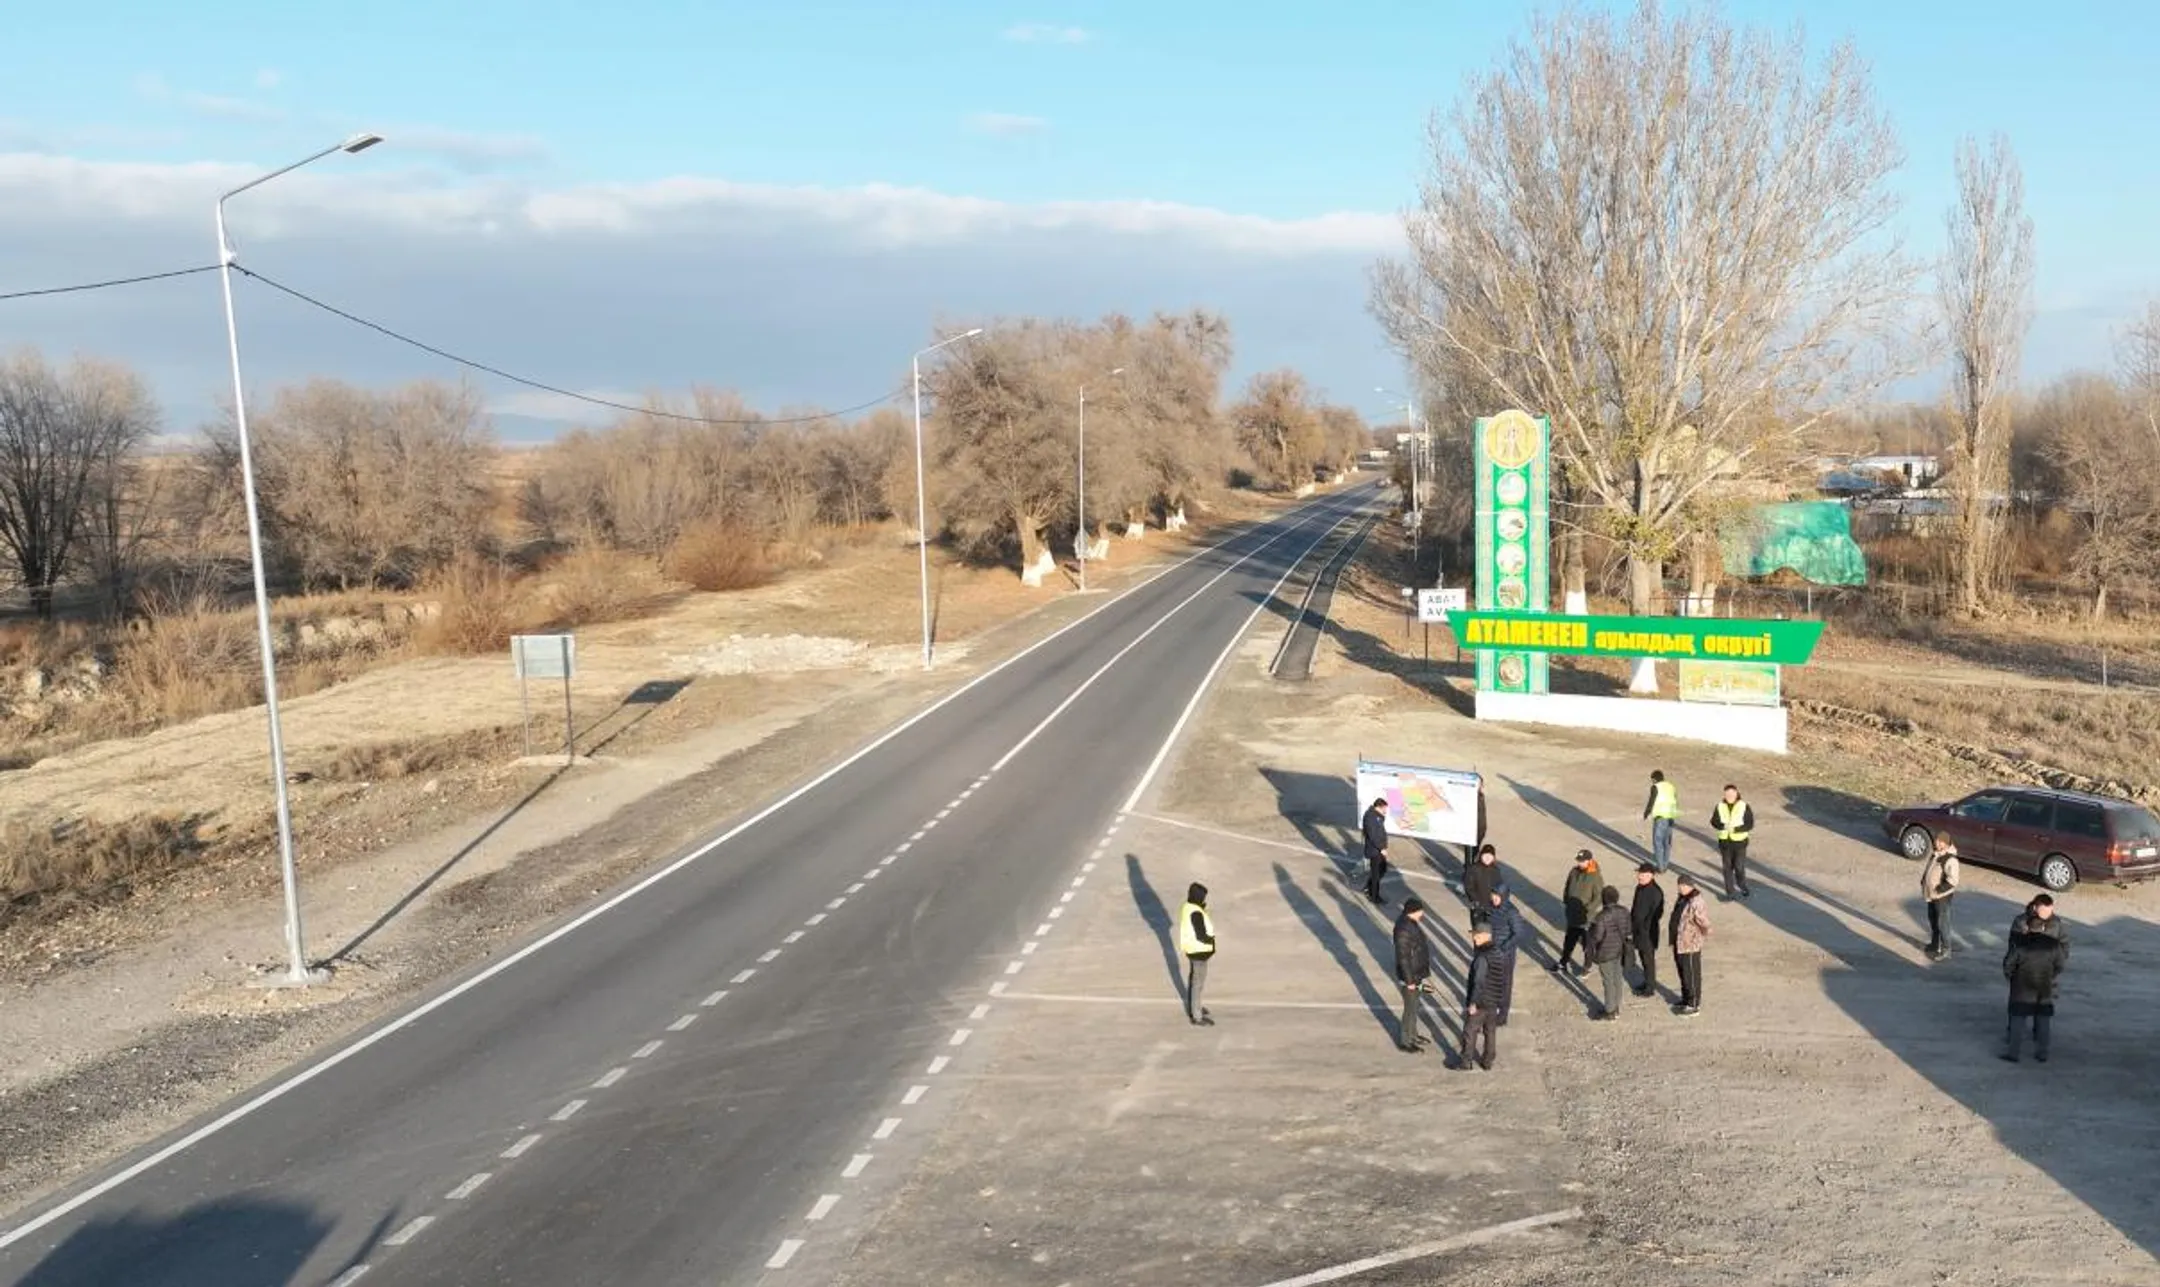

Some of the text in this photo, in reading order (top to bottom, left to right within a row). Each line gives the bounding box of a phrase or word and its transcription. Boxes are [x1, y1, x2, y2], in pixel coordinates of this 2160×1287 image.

[1466, 618, 1772, 657] АТАМЕКЕН ауылдық округі
